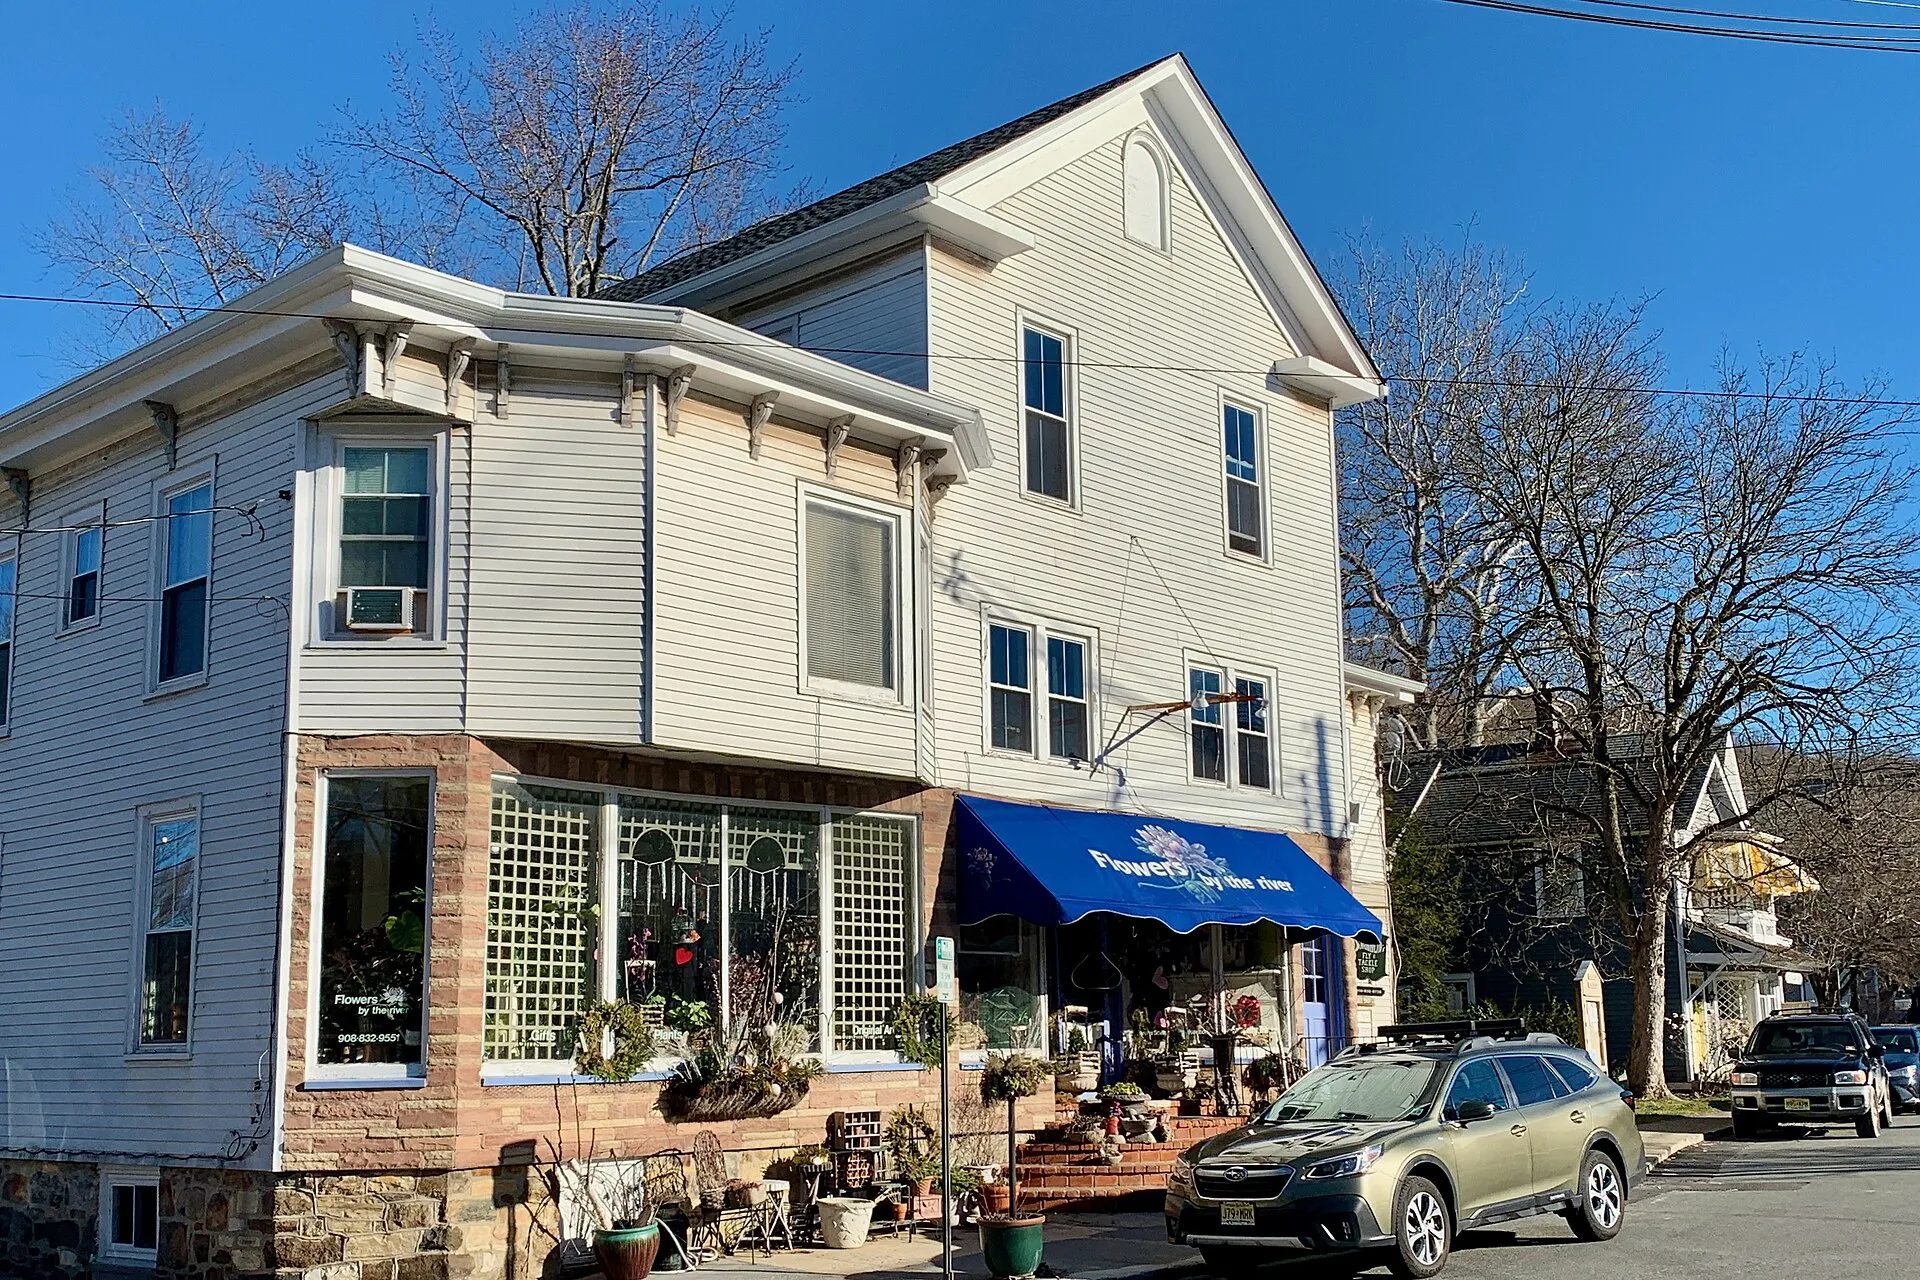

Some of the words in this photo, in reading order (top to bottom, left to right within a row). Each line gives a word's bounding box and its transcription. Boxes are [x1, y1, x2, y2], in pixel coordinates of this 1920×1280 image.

[1088, 848, 1189, 877] Flowers
[1197, 872, 1224, 892] by
[1223, 874, 1255, 889] the
[1256, 875, 1294, 892] river
[1358, 959, 1378, 967] TACKLE
[334, 994, 379, 1005] Flowers
[358, 1006, 370, 1017] by
[371, 1006, 388, 1015] the
[389, 1006, 409, 1015] river
[530, 1029, 557, 1042] Gifts
[653, 1029, 683, 1041] Plants
[852, 1024, 883, 1037] Original
